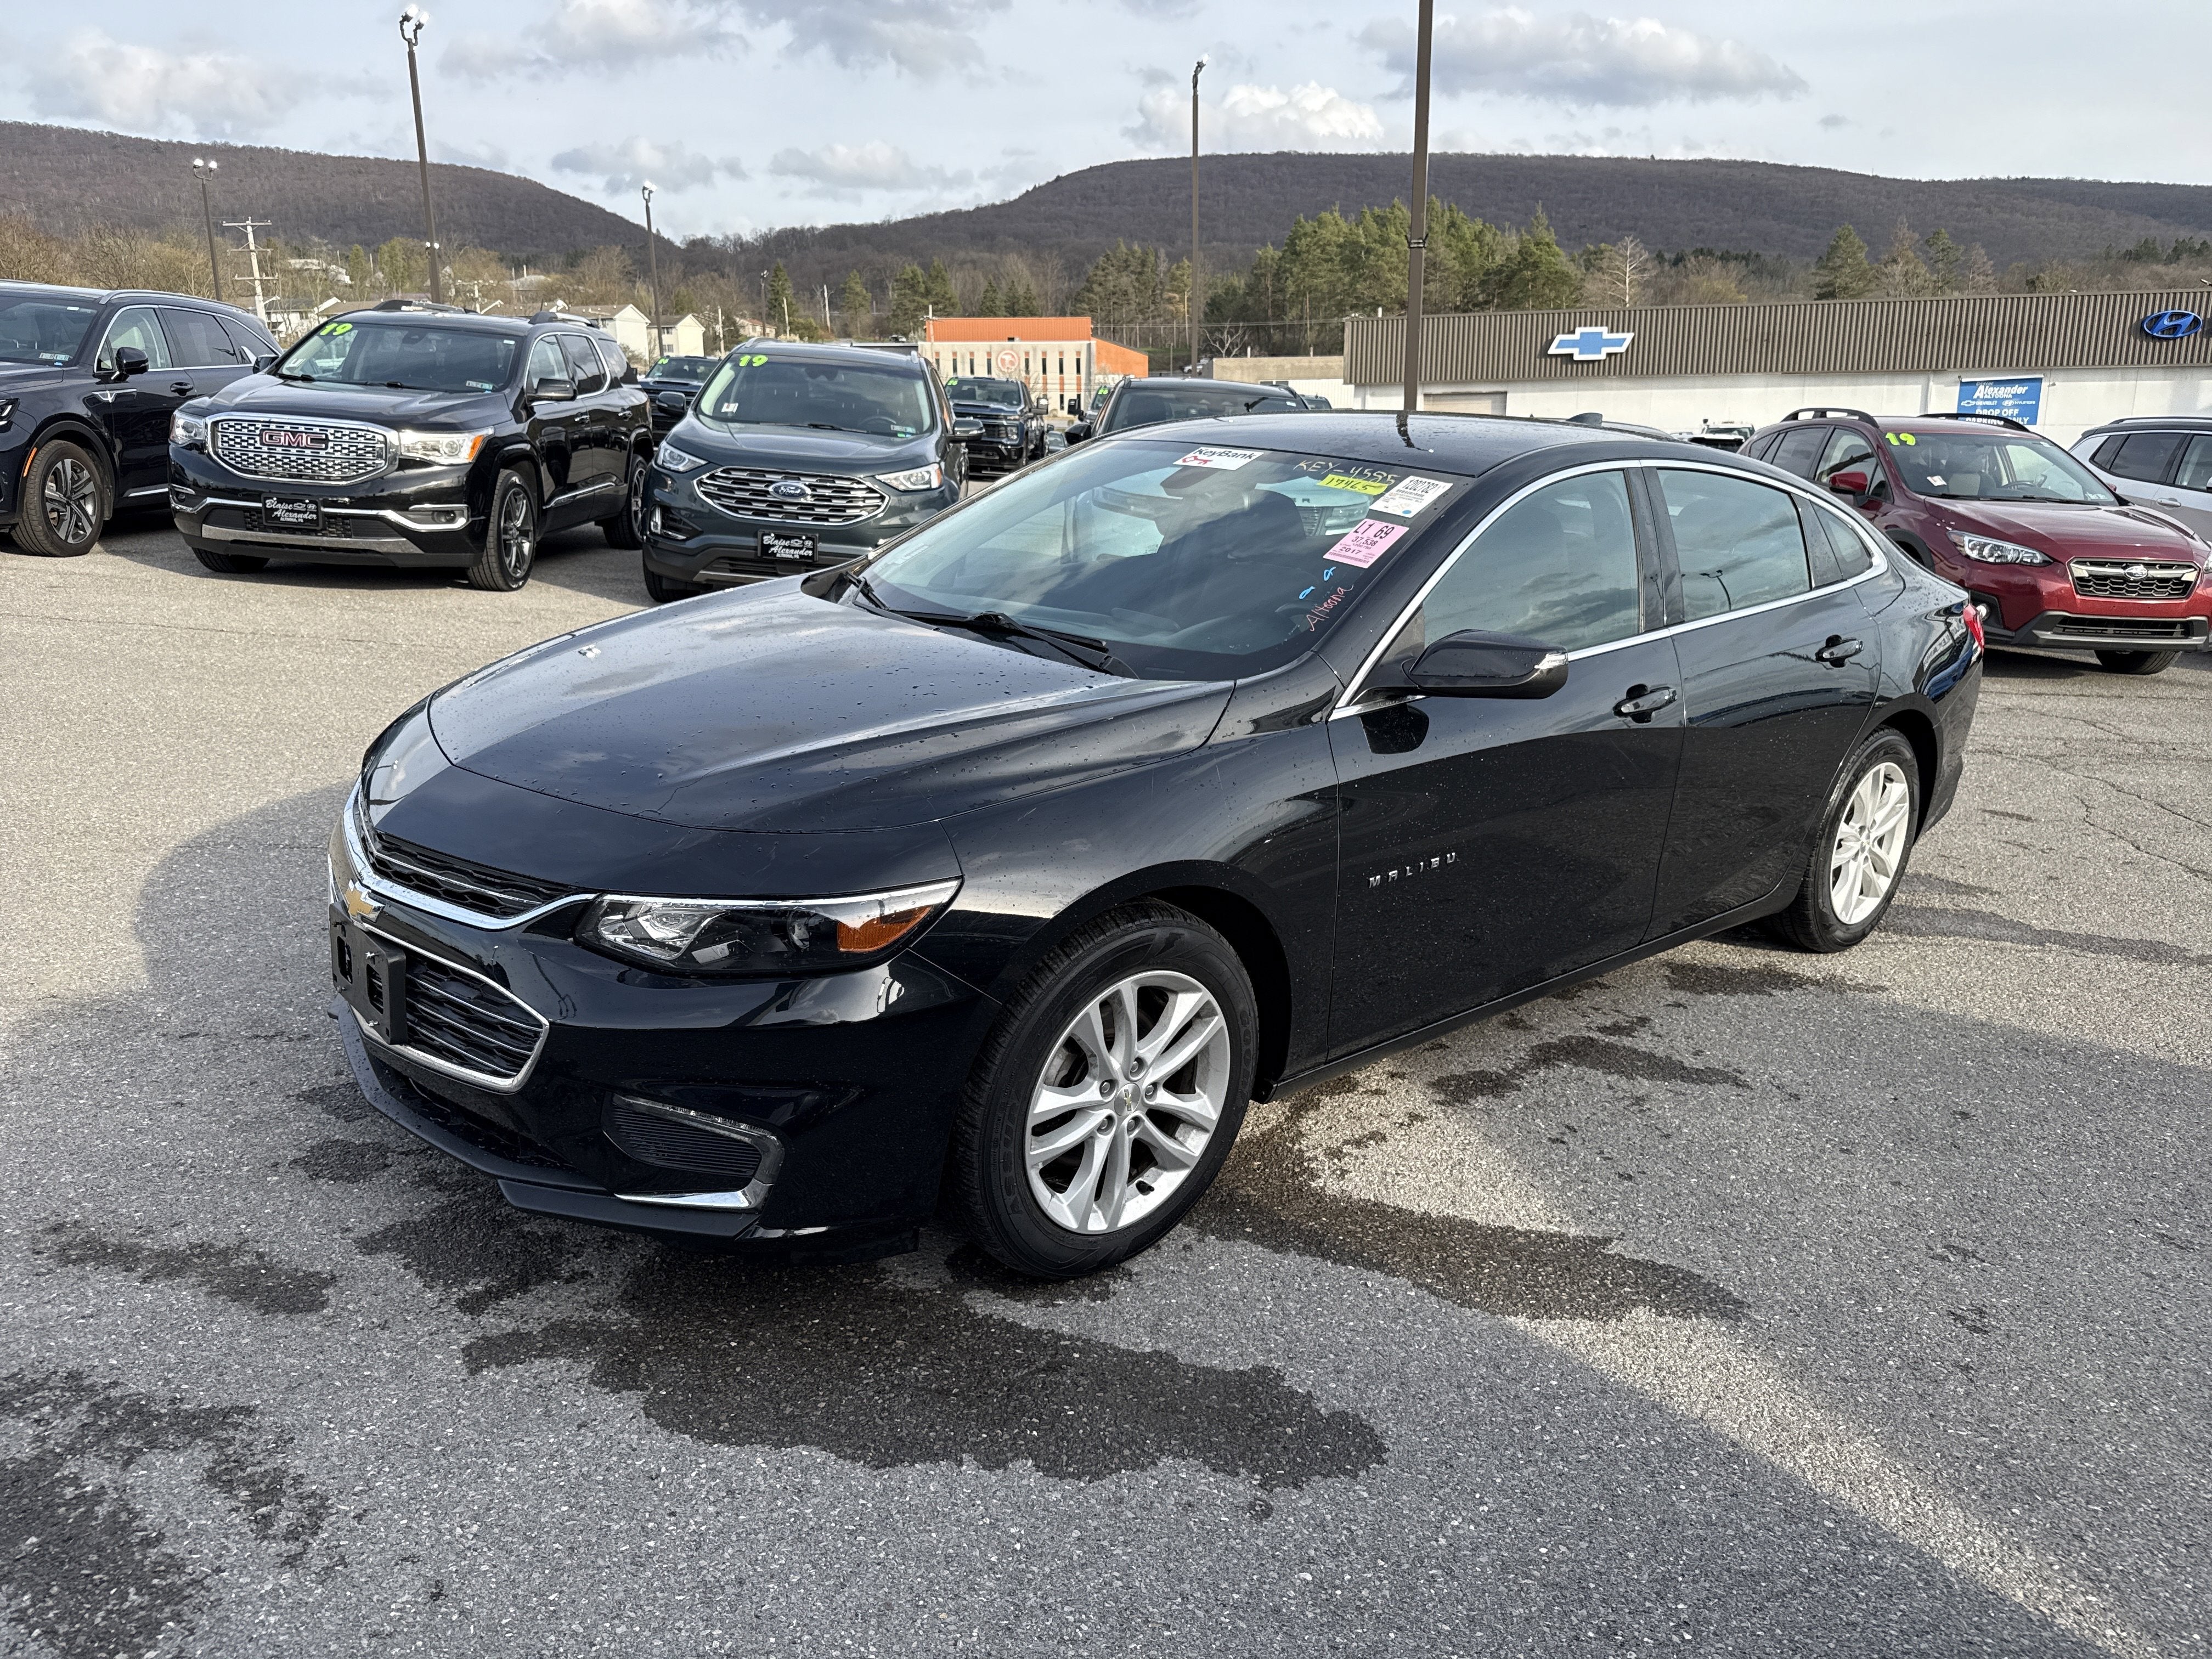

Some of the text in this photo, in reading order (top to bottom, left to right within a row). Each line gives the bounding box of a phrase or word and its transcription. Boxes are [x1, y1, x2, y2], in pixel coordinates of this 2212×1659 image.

[320, 323, 353, 336] 19
[739, 355, 768, 366] 19
[1973, 385, 2028, 399] Alexander
[263, 431, 325, 448] GMC
[1885, 432, 1916, 445] 19
[1193, 448, 1257, 460] KeyBank
[779, 486, 800, 495] Ford
[266, 499, 293, 510] Blaise
[272, 509, 317, 520] Alexander
[1374, 525, 1395, 539] 69
[763, 535, 790, 546] Blaise
[1351, 536, 1379, 546] 37,538
[769, 545, 813, 556] Alexander
[1339, 546, 1362, 555] 2017
[1306, 584, 1354, 631] Altoona
[1369, 852, 1455, 888] MALIBU
